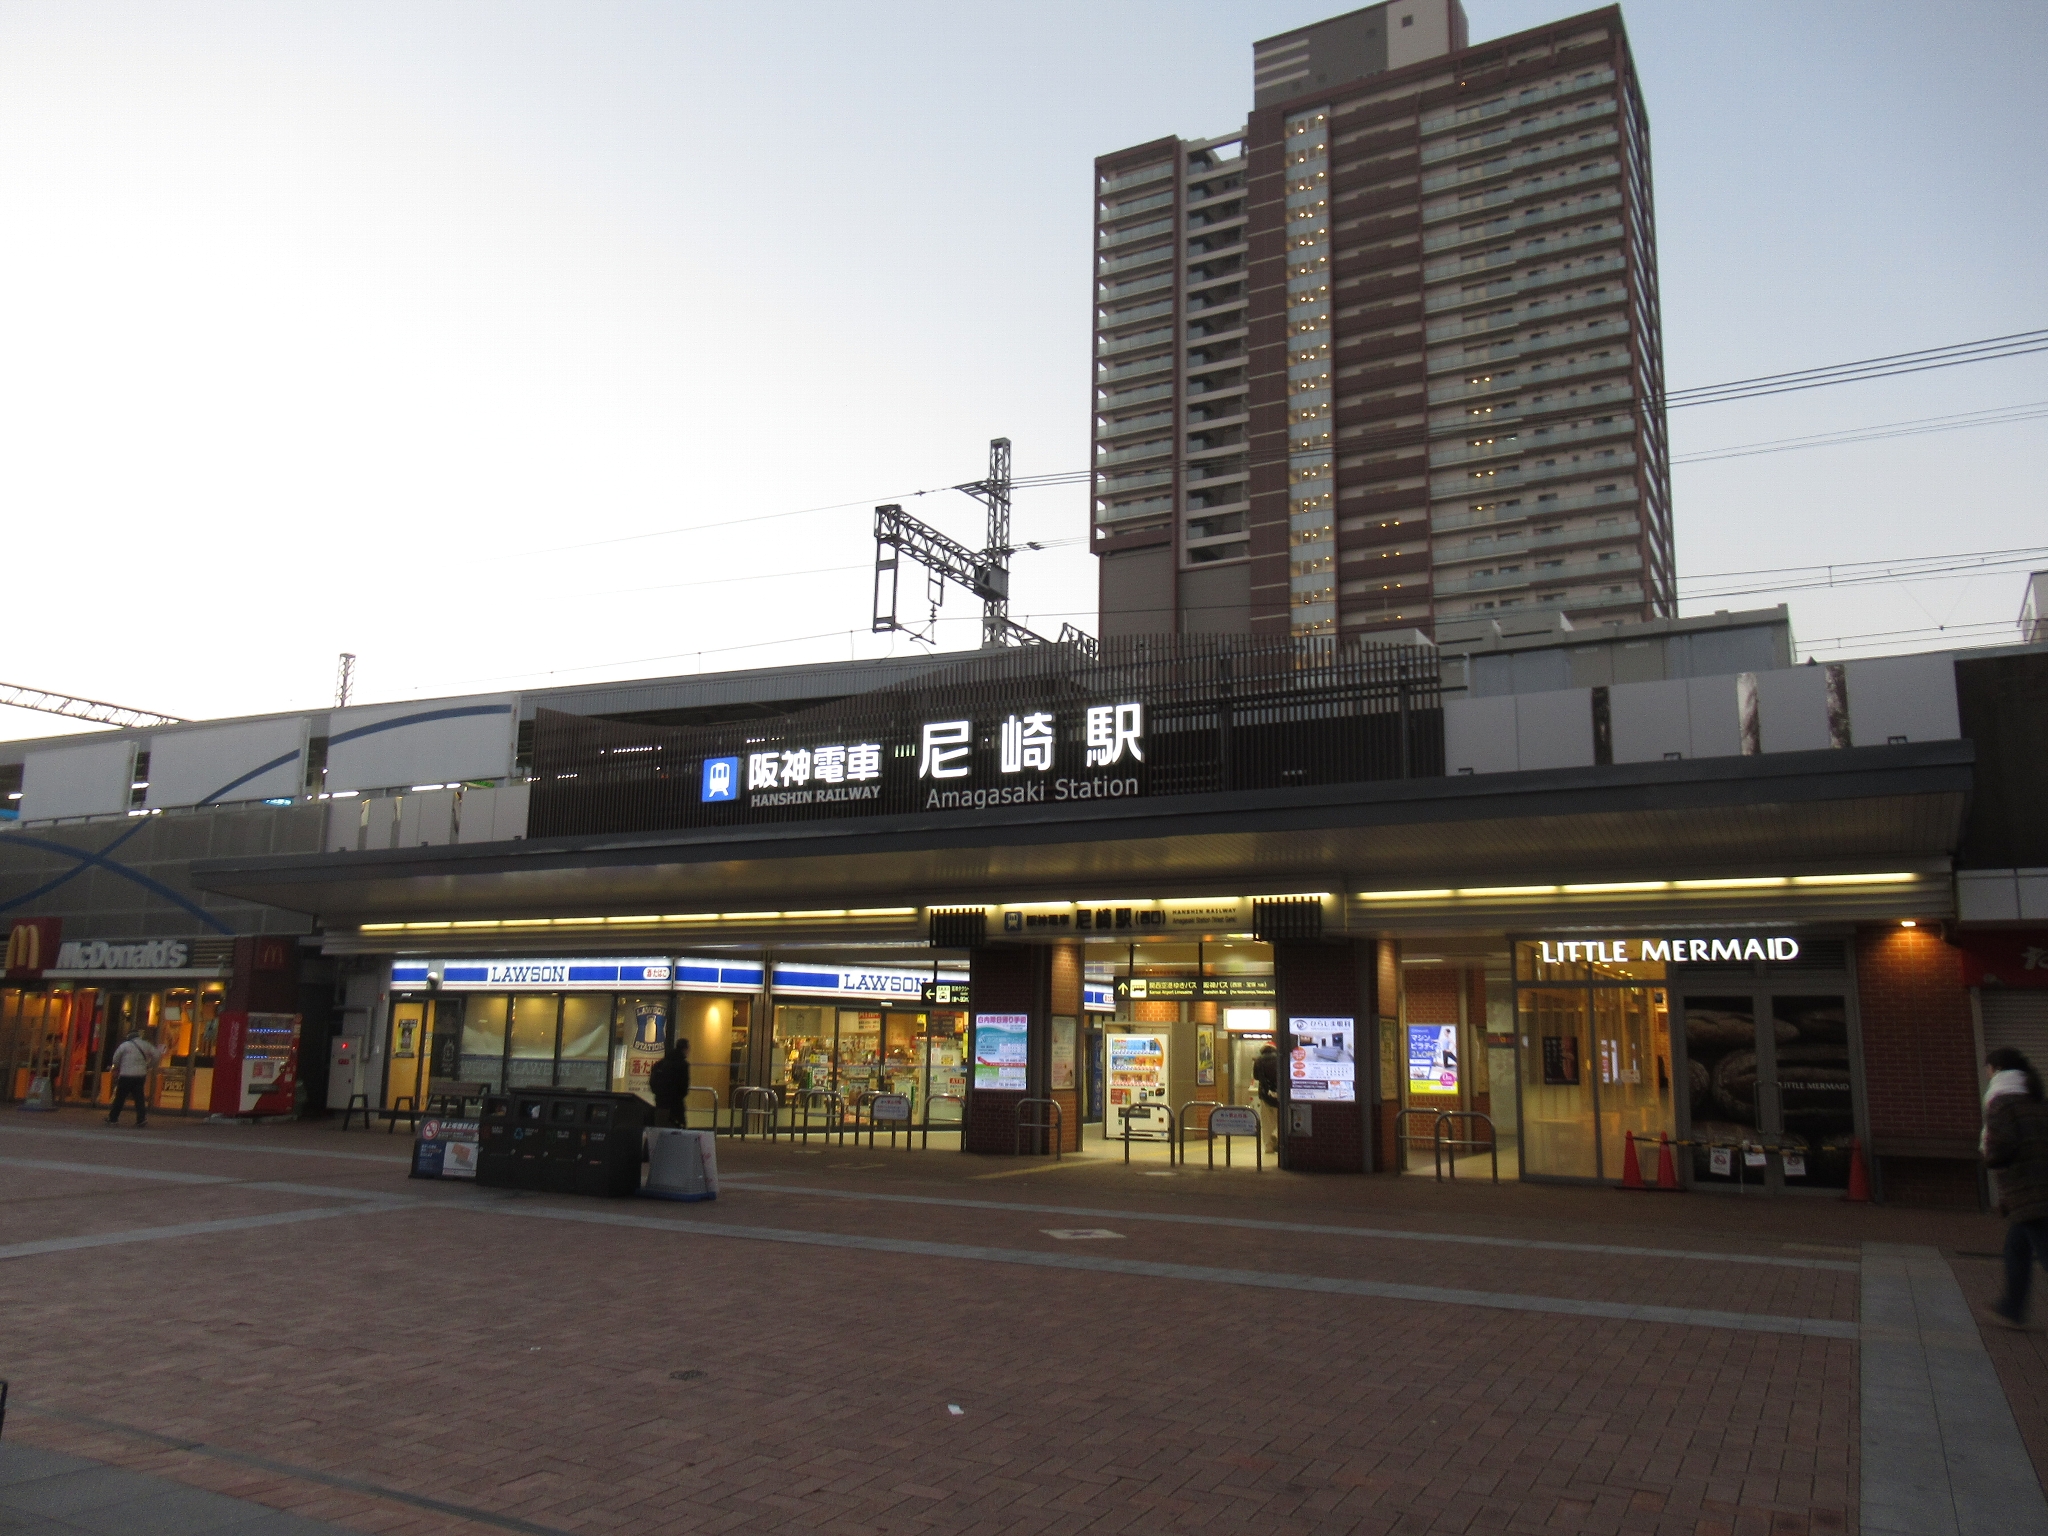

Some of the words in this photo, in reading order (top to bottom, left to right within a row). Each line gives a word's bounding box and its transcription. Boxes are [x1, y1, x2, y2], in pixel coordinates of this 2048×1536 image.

[918, 702, 1145, 779] 尼崎駅
[748, 743, 882, 791] 阪神電車
[751, 791, 812, 808] HANSHIN
[815, 785, 881, 803] RAILWAY
[926, 780, 1045, 811] Amagasaki
[1055, 776, 1139, 801] Station
[57, 940, 190, 969] McDonald's
[1541, 940, 1628, 963] LITTLE
[1641, 937, 1799, 961] MERMAID
[491, 965, 566, 982] LAWSON
[636, 1006, 667, 1016] LAWSON
[634, 1041, 665, 1052] STATION
